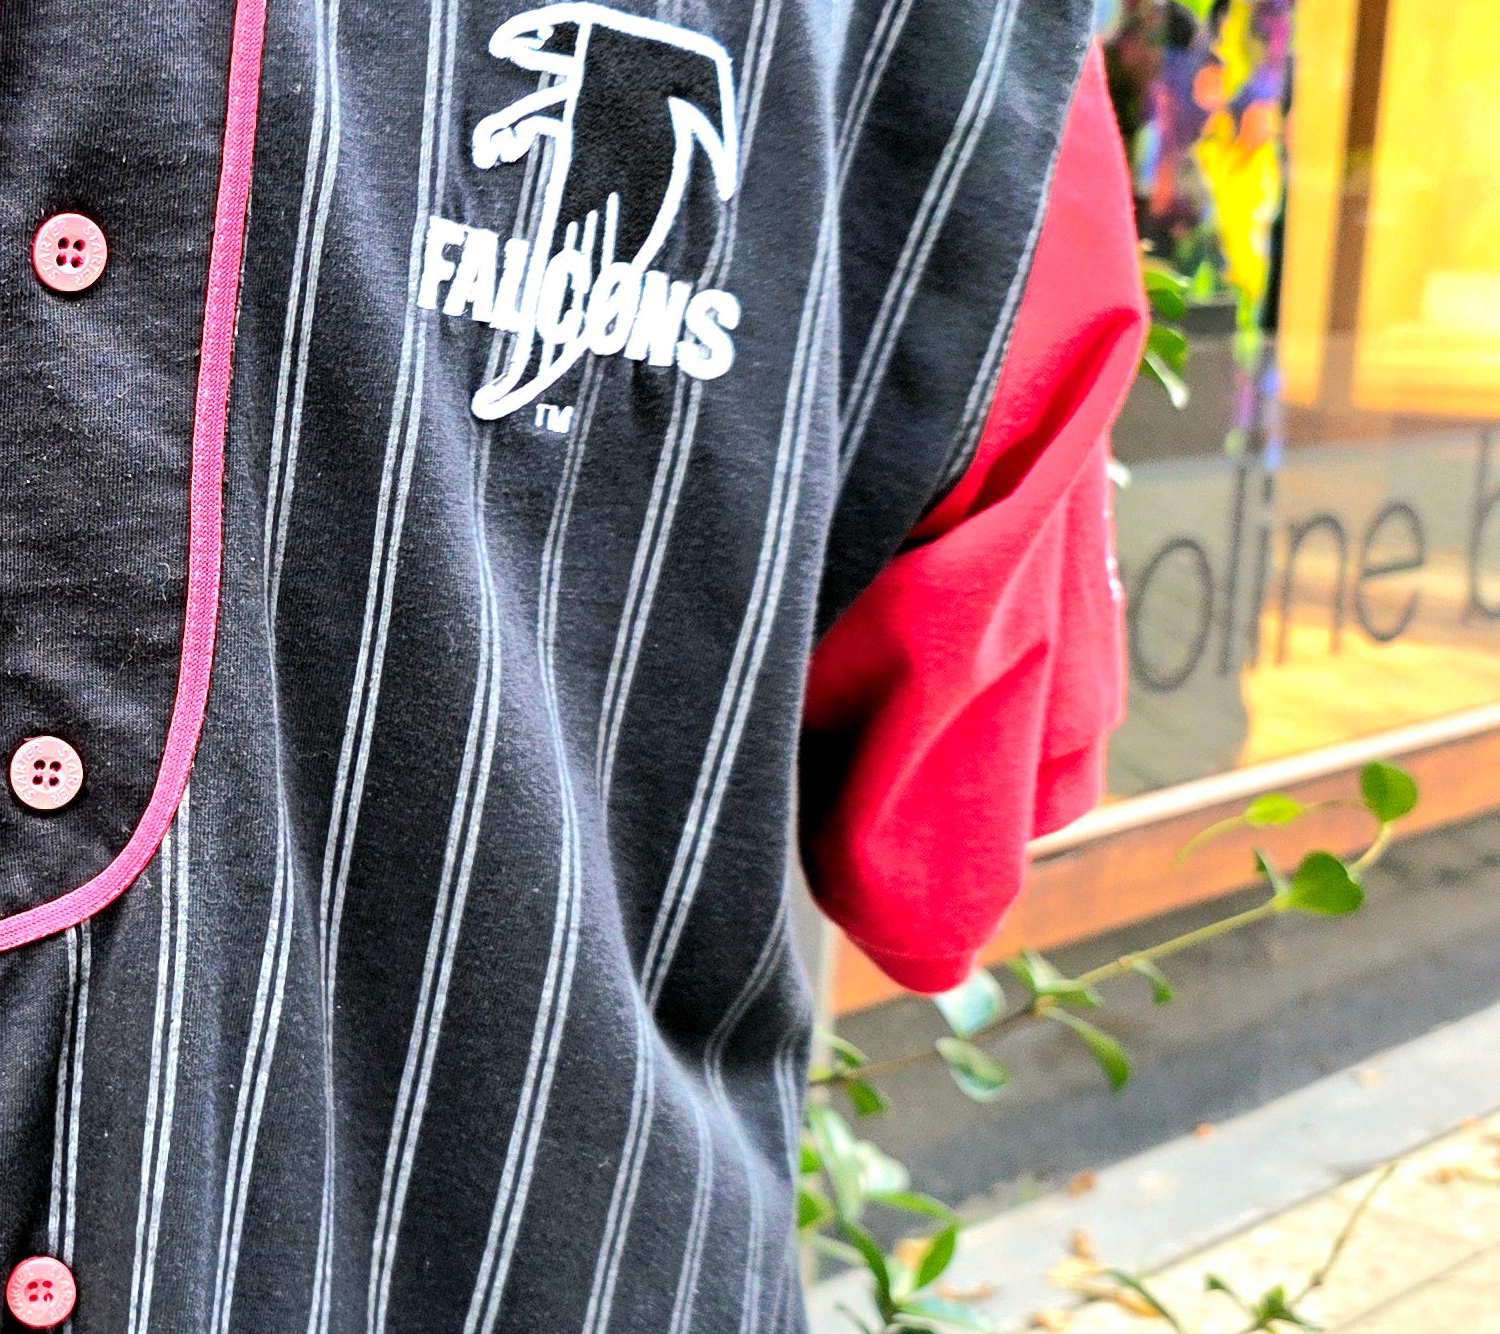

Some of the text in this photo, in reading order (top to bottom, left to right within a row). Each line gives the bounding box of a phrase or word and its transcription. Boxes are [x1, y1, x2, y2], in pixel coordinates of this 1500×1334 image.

[417, 215, 741, 380] FALCONS
[535, 403, 574, 433] TM
[1117, 462, 1425, 694] oline
